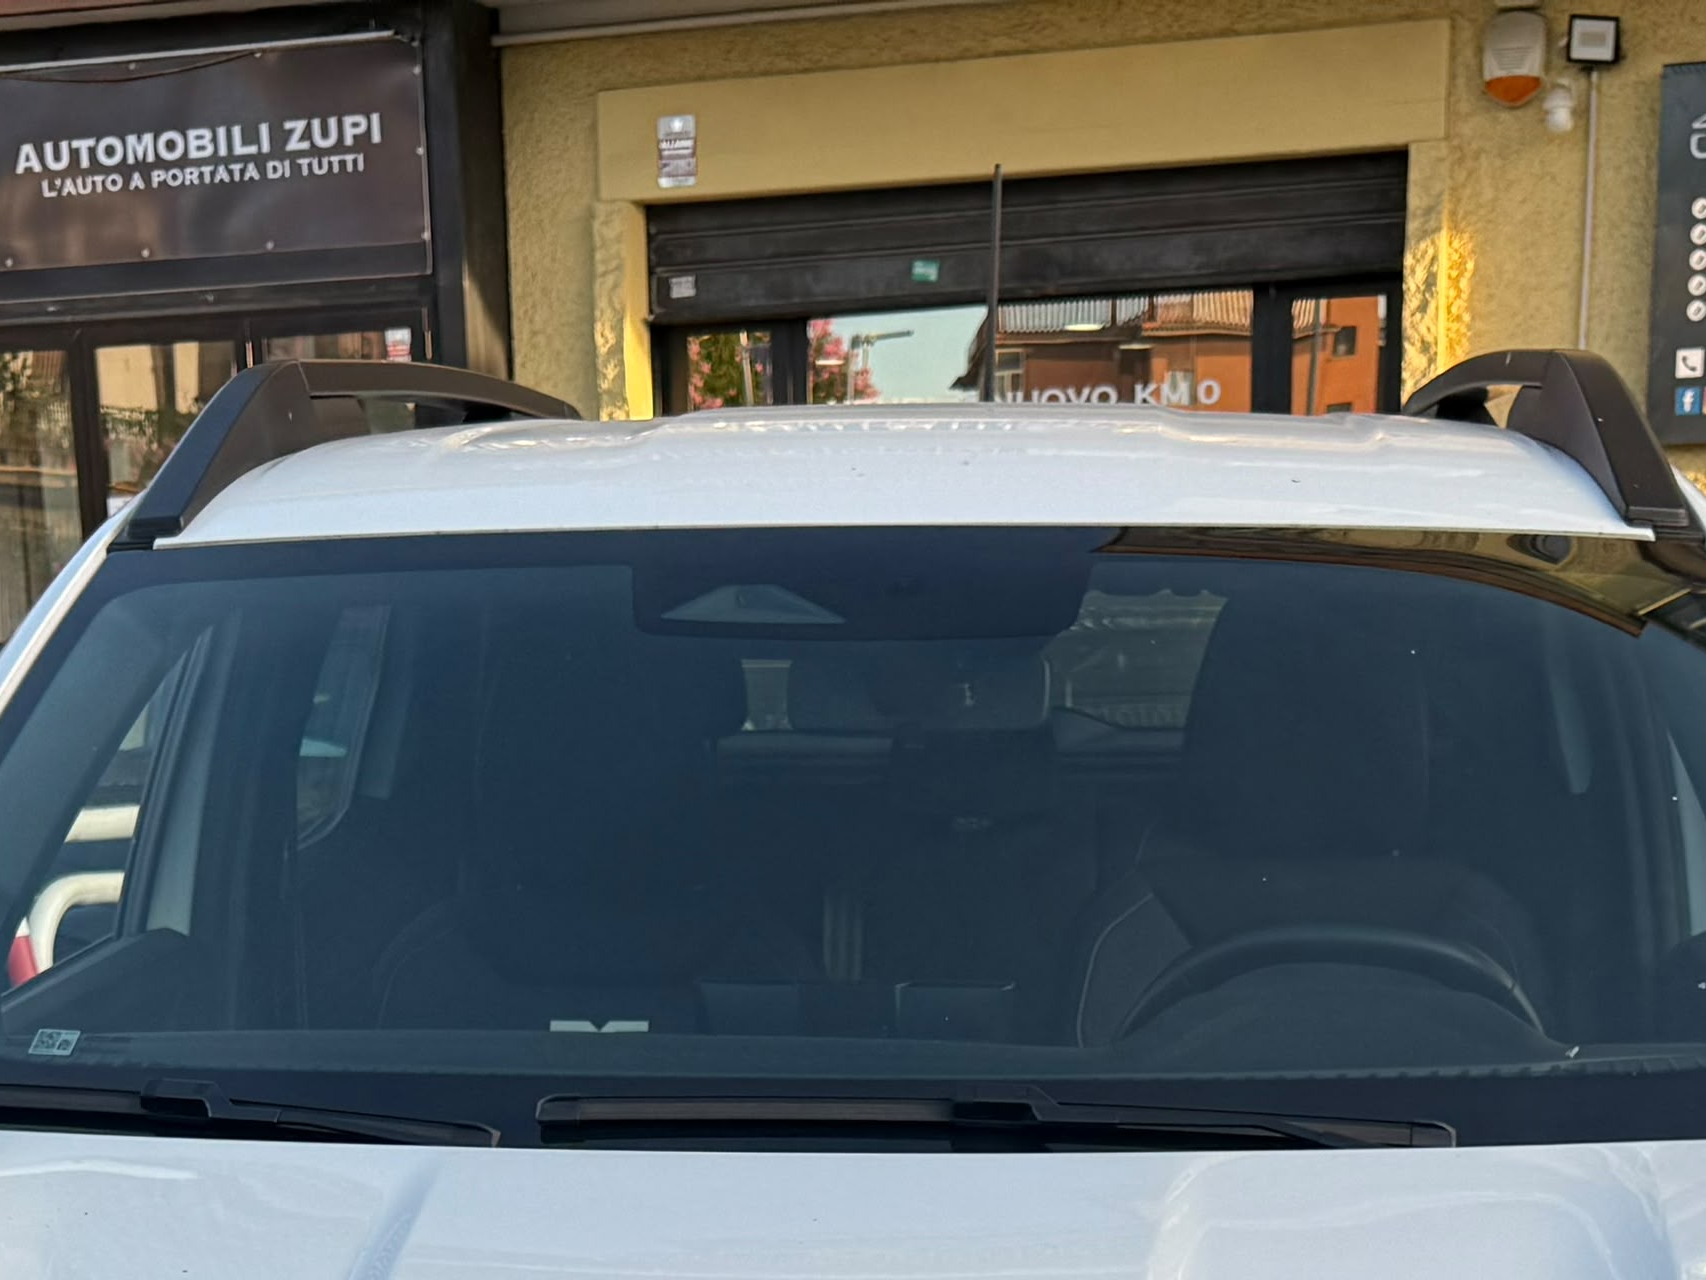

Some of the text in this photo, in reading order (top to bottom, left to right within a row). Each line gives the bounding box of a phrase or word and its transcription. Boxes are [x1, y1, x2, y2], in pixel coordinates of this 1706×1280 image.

[15, 112, 382, 174] AUTOMOBILI ZUPI
[41, 153, 365, 198] L'AUTO A PORTATA DI TUTTI
